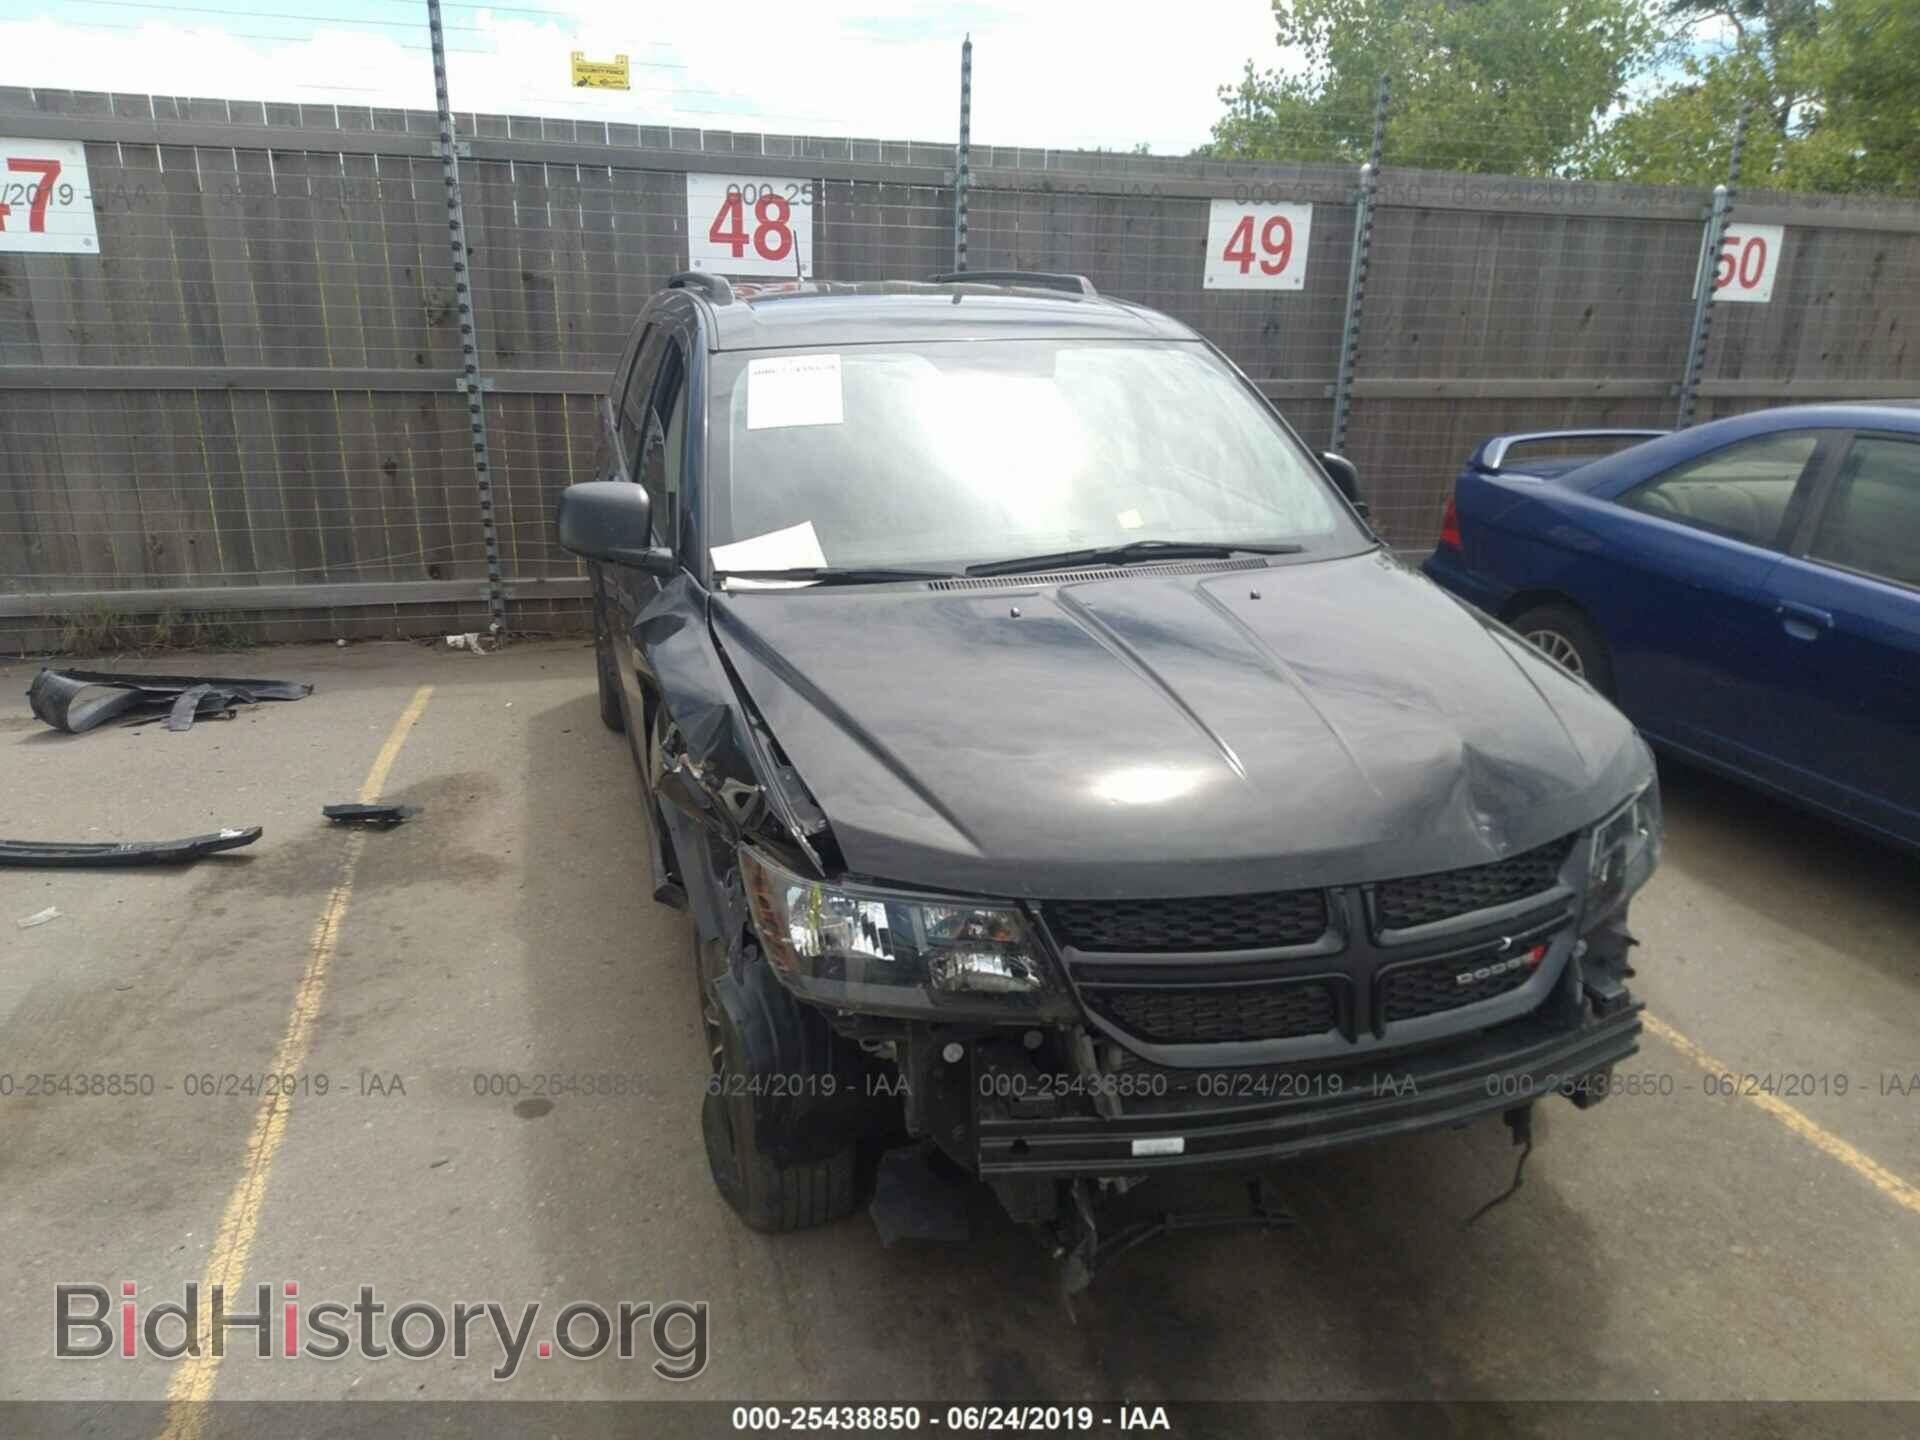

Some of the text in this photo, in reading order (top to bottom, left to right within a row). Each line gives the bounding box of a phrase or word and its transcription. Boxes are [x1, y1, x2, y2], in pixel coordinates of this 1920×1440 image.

[709, 191, 792, 261] 48
[1223, 215, 1293, 275] 49
[1716, 237, 1767, 289] 50
